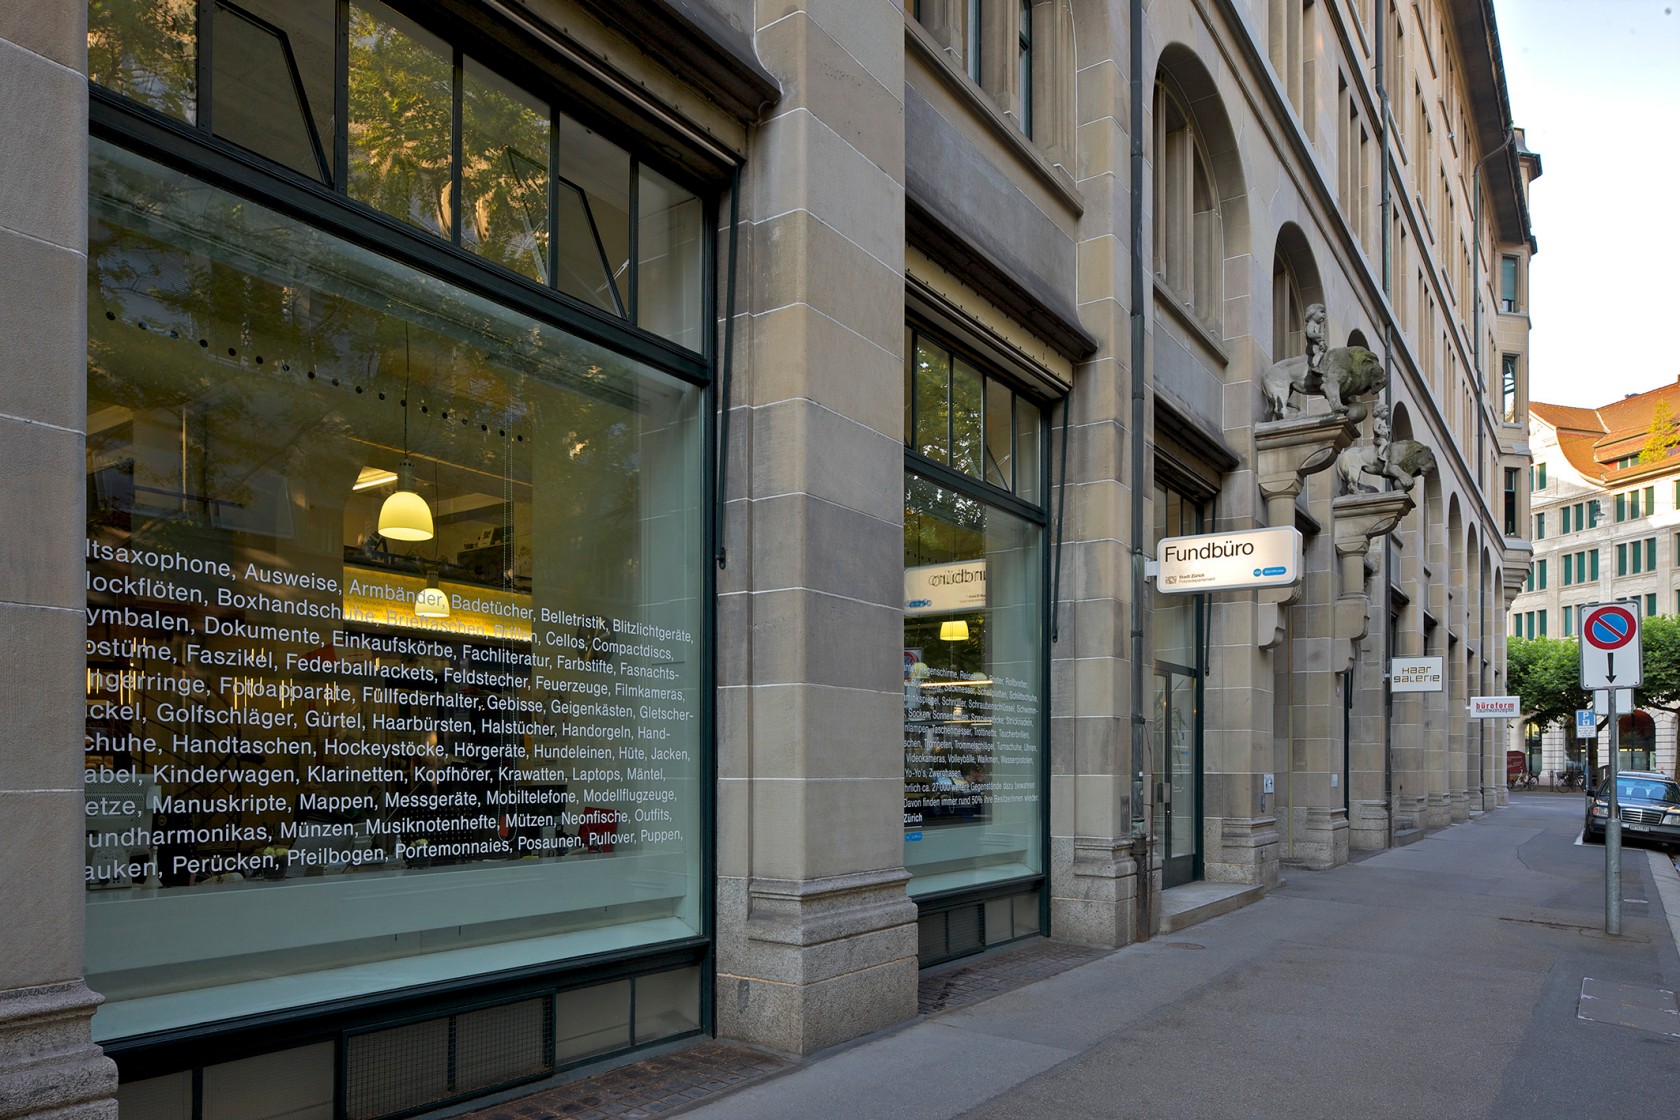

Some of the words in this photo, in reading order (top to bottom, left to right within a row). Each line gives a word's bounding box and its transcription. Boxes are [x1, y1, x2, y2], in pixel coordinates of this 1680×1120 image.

[1165, 540, 1254, 562] Fundbüro
[244, 563, 342, 596] Ausweise,
[350, 579, 445, 609] Armbänder,
[452, 595, 536, 622] Badetücher,
[542, 608, 609, 631] Belletristik,
[613, 619, 694, 644] Blitzlichtgeräte,
[86, 571, 208, 606] lockflöten,
[218, 588, 379, 627] Boxhandschuhe,
[387, 610, 488, 637] Brieftaschen,
[494, 624, 541, 646] Brillen,
[546, 631, 588, 651] Cellos,
[593, 638, 674, 662] Compactdiscs,
[86, 608, 195, 635] ymbalen,
[205, 616, 325, 647] Dokumente,
[333, 630, 456, 661] Einkaufskörbe,
[463, 646, 552, 670] Fachliteratur,
[557, 656, 616, 676] Farbstifte,
[620, 662, 679, 681] Fasnachts-
[187, 644, 278, 671] Faszikel,
[286, 654, 438, 683] Federballrackets,
[444, 668, 531, 689] Feldstecher,
[536, 676, 611, 697] Feuerzeuge,
[615, 684, 685, 702] Filmkameras,
[1402, 666, 1431, 674] Haar
[220, 677, 355, 705] Fotoapparate,
[363, 686, 482, 710] Füllfederhalter,
[488, 695, 546, 715] Gebisse,
[551, 701, 636, 719] Geigenkästen,
[640, 706, 694, 721] Gletscher-
[86, 702, 147, 723] ckel,
[157, 703, 297, 729] Golfschläger,
[306, 712, 365, 731] Gürtel,
[373, 713, 476, 735] Haarbürsten,
[482, 719, 557, 737] Halstücher,
[562, 723, 633, 740] Handorgeln,
[638, 727, 670, 740] Hand-
[908, 707, 931, 720] Socken,
[932, 724, 972, 736] Taschenmesser,
[85, 733, 163, 756] chuhe,
[173, 736, 317, 757] Handtaschen,
[325, 739, 449, 760] Hockeystöcke,
[454, 744, 529, 761] Hörgeräte,
[534, 745, 614, 761] Hundeleinen,
[619, 746, 647, 762] Hüte,
[651, 748, 690, 762] Jacken,
[924, 738, 953, 750] Trompeten,
[906, 753, 946, 764] Videokameras,
[948, 753, 976, 764] Volleybälle,
[85, 765, 143, 786] abel,
[154, 764, 300, 786] Kinderwagen,
[308, 765, 408, 784] Klarinetten,
[415, 767, 493, 785] Kopfhörer,
[499, 766, 567, 783] Krawatten,
[572, 768, 623, 784] Laptops,
[627, 768, 666, 782] Mäntel,
[970, 781, 1002, 792] Gegenstände
[85, 798, 142, 817] etze,
[153, 795, 291, 815] Manuskripte,
[300, 792, 378, 814] Mappen,
[386, 792, 481, 810] Messgeräte,
[487, 790, 579, 806] Mobiltelefone,
[584, 787, 677, 806] Modellflugzeuge,
[904, 798, 921, 807] Davon
[923, 797, 940, 806] finden
[941, 797, 958, 806] immer
[959, 796, 970, 805] rund
[971, 795, 982, 804] 50%
[89, 825, 272, 848] undharmonikas,
[281, 821, 359, 839] Münzen,
[366, 814, 500, 835] Musiknotenhefte,
[506, 812, 556, 829] Mützen,
[562, 810, 631, 826] Neonfische,
[635, 808, 672, 822] Outfits,
[904, 813, 922, 823] Zürich
[85, 858, 163, 880] auken,
[173, 854, 279, 875] Perücken,
[288, 844, 389, 868] Pfeilbogen,
[396, 838, 513, 860] Portemonnaies,
[518, 834, 584, 851] Posaunen,
[589, 830, 637, 847] Pullover,
[641, 828, 683, 843] Puppen,
